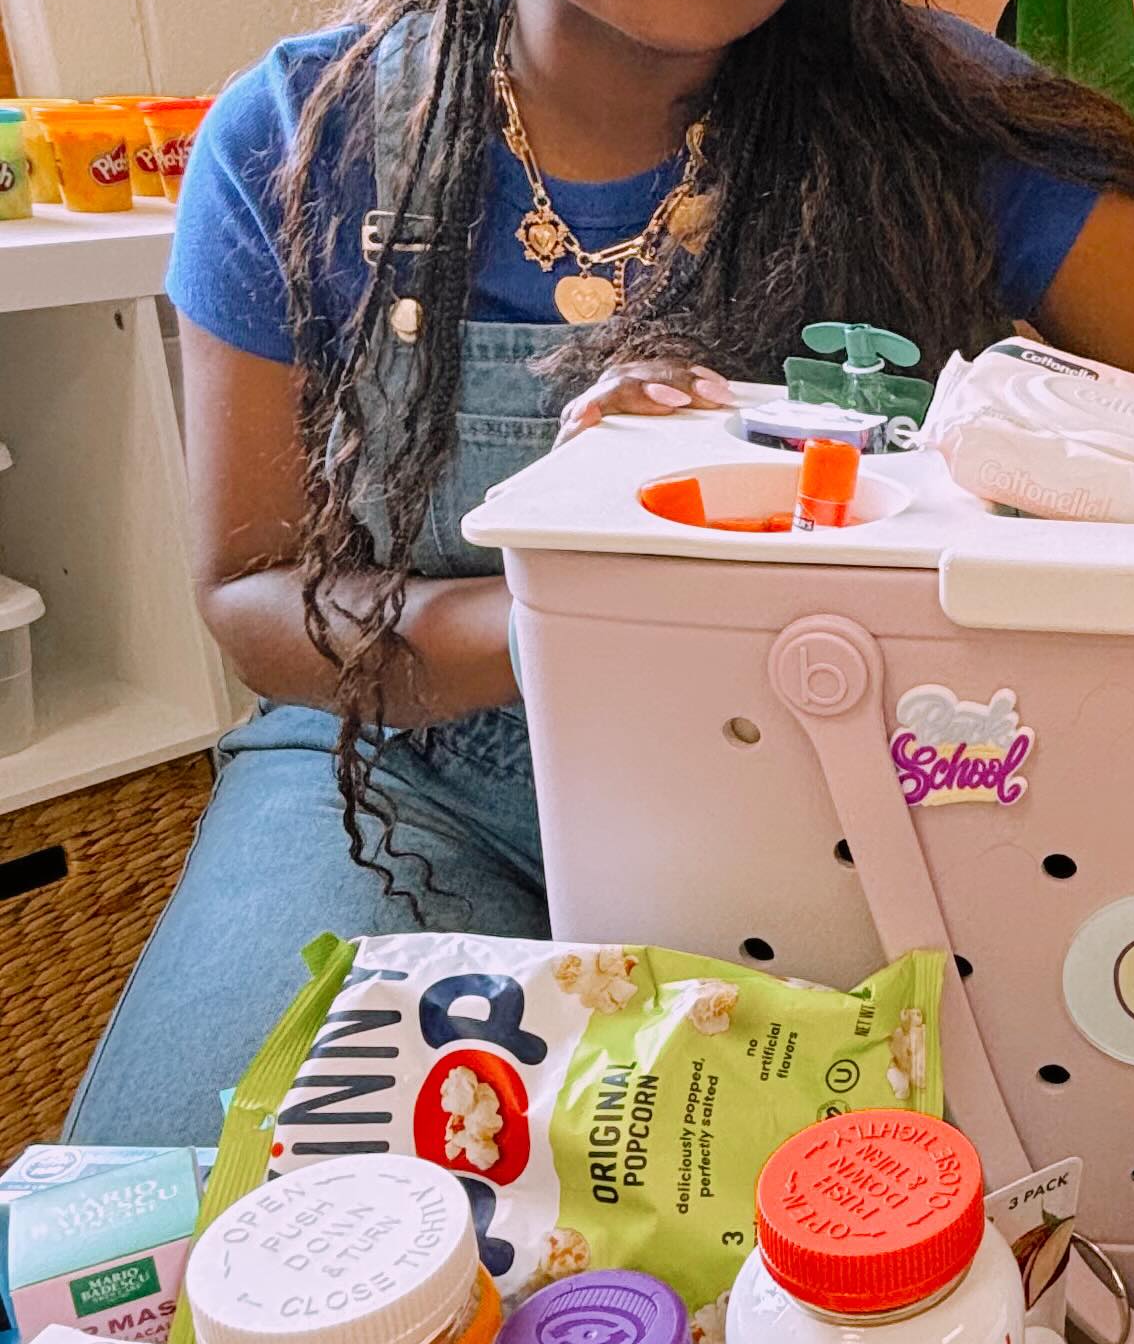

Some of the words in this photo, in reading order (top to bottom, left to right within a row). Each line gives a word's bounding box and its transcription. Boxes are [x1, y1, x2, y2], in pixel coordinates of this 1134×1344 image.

[891, 733, 1030, 804] School
[746, 1039, 758, 1057] no
[760, 1022, 782, 1082] artificial
[776, 1031, 799, 1079] flavors
[684, 1057, 706, 1125] popped,
[702, 1075, 720, 1128] salted
[588, 1060, 638, 1205] ORIGINAL
[623, 1074, 660, 1187] POPCORN
[675, 1128, 696, 1214] deliciously
[700, 1129, 715, 1198] perfectly
[1008, 1196, 1019, 1210] 3
[1023, 1172, 1069, 1203] PACK
[260, 1199, 334, 1254] PUSH
[88, 1267, 140, 1290] MARIO
[280, 1272, 397, 1318] CLOSE
